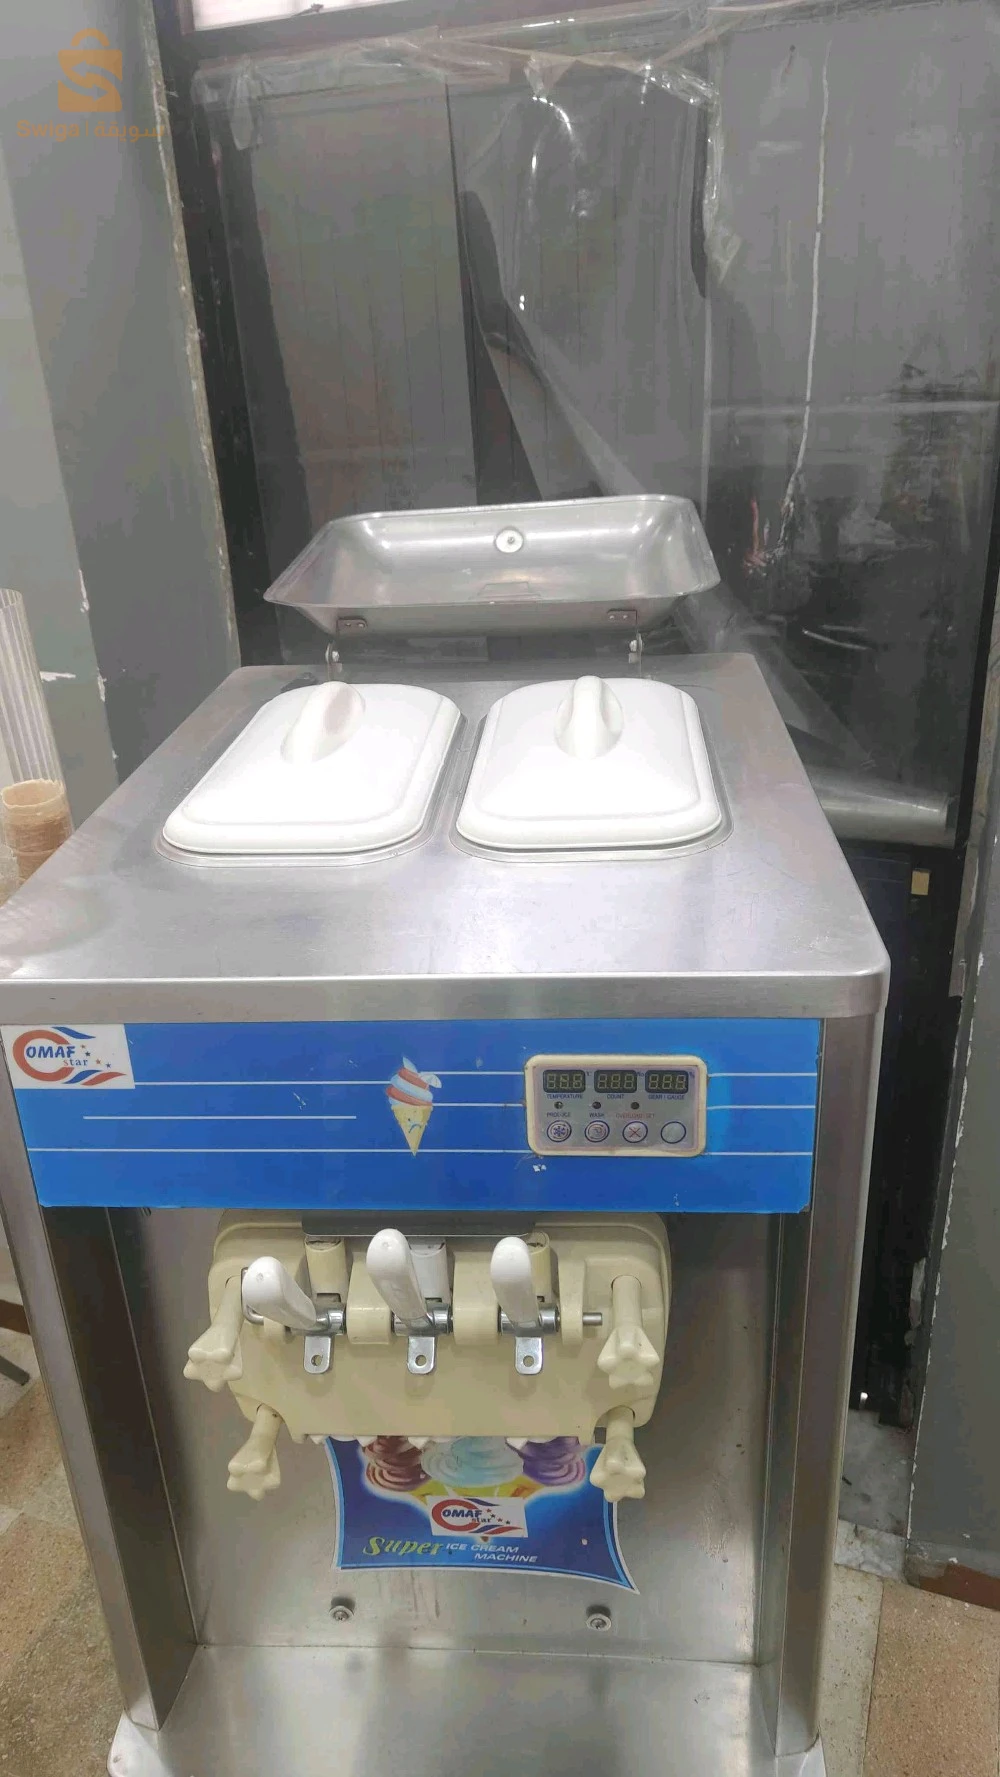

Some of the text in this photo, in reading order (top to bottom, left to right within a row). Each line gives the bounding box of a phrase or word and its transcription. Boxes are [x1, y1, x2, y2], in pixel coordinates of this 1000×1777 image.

[63, 1059, 89, 1067] star
[362, 1536, 520, 1557] Super ICE CREAM
[474, 1553, 539, 1563] MACHINE
